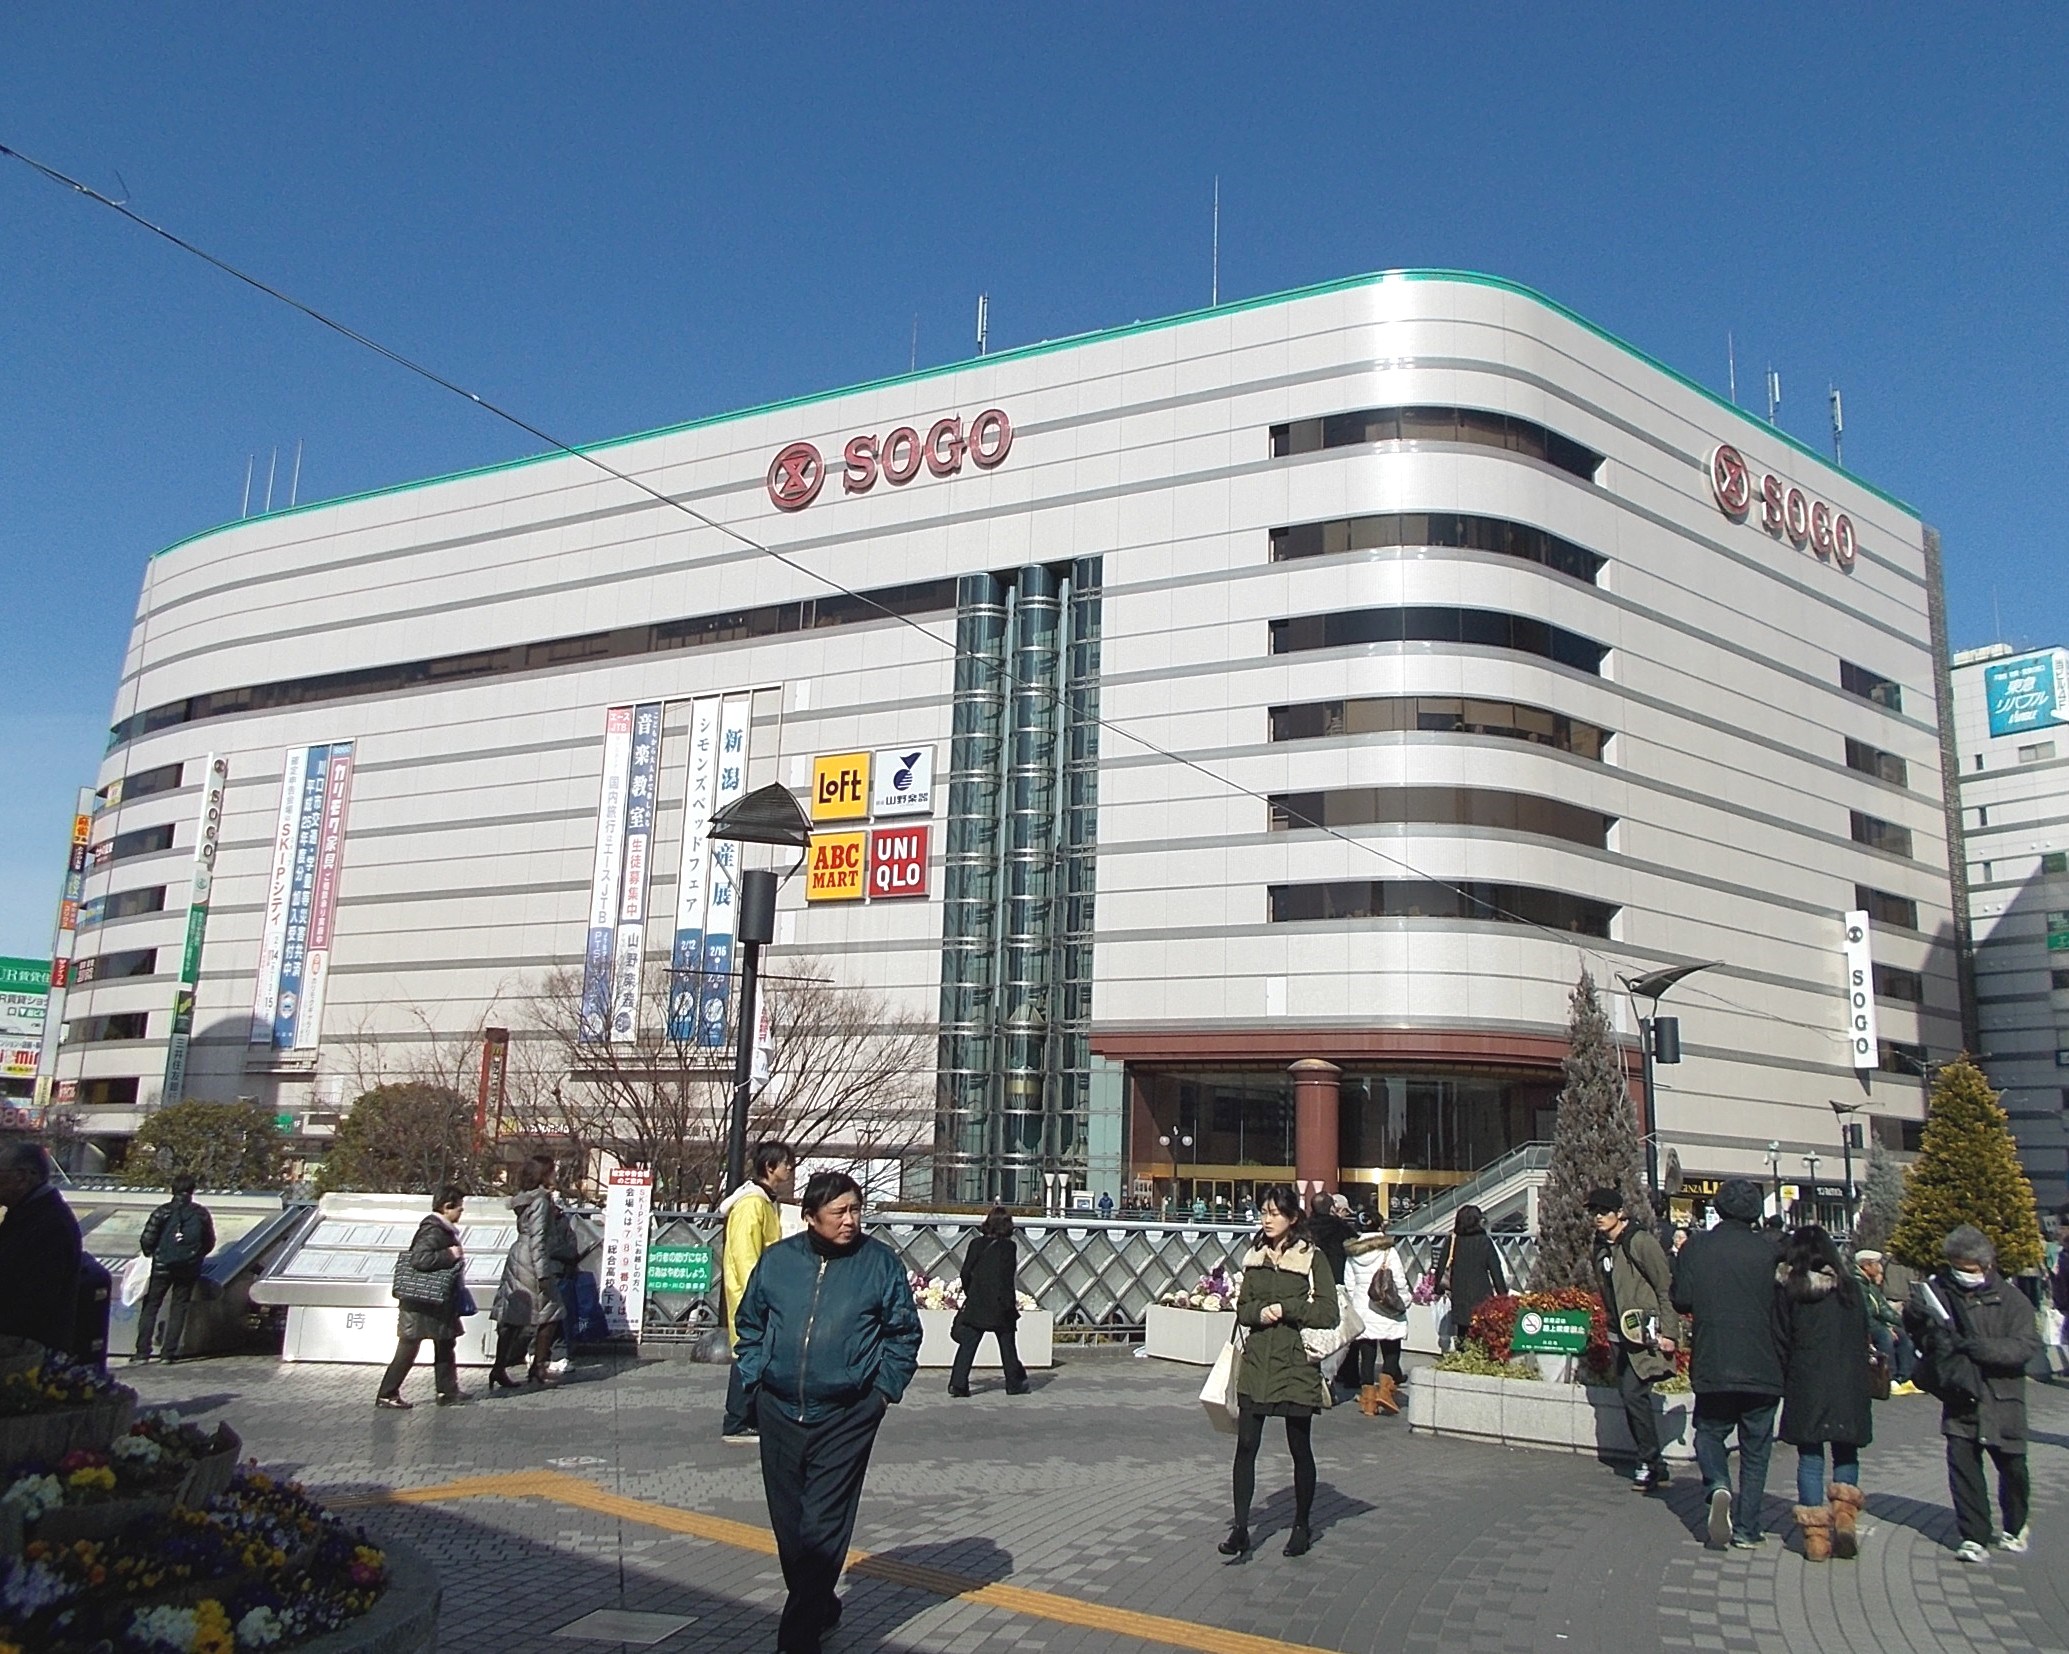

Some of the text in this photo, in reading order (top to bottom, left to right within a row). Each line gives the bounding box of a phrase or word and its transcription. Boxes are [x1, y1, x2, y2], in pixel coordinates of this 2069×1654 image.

[843, 408, 1013, 494] SOGO
[1761, 474, 1857, 566] SOGO
[609, 712, 631, 721] エース
[610, 722, 628, 732] JTB
[629, 713, 653, 829] 音楽教室
[203, 788, 221, 857] SOGO
[686, 717, 711, 912] シモンズベッドフェア
[712, 728, 744, 907] 新潟産展
[885, 792, 929, 806] 山野楽器
[813, 843, 860, 870] ABC
[877, 835, 918, 862] UNI
[271, 823, 292, 926] SKIPシティ
[626, 837, 643, 917] 生徒募集中
[812, 870, 859, 889] MART
[876, 862, 921, 892] QLO
[710, 946, 727, 957] 2/16
[1852, 969, 1869, 1054] SOGO
[346, 1312, 366, 1330] 時
